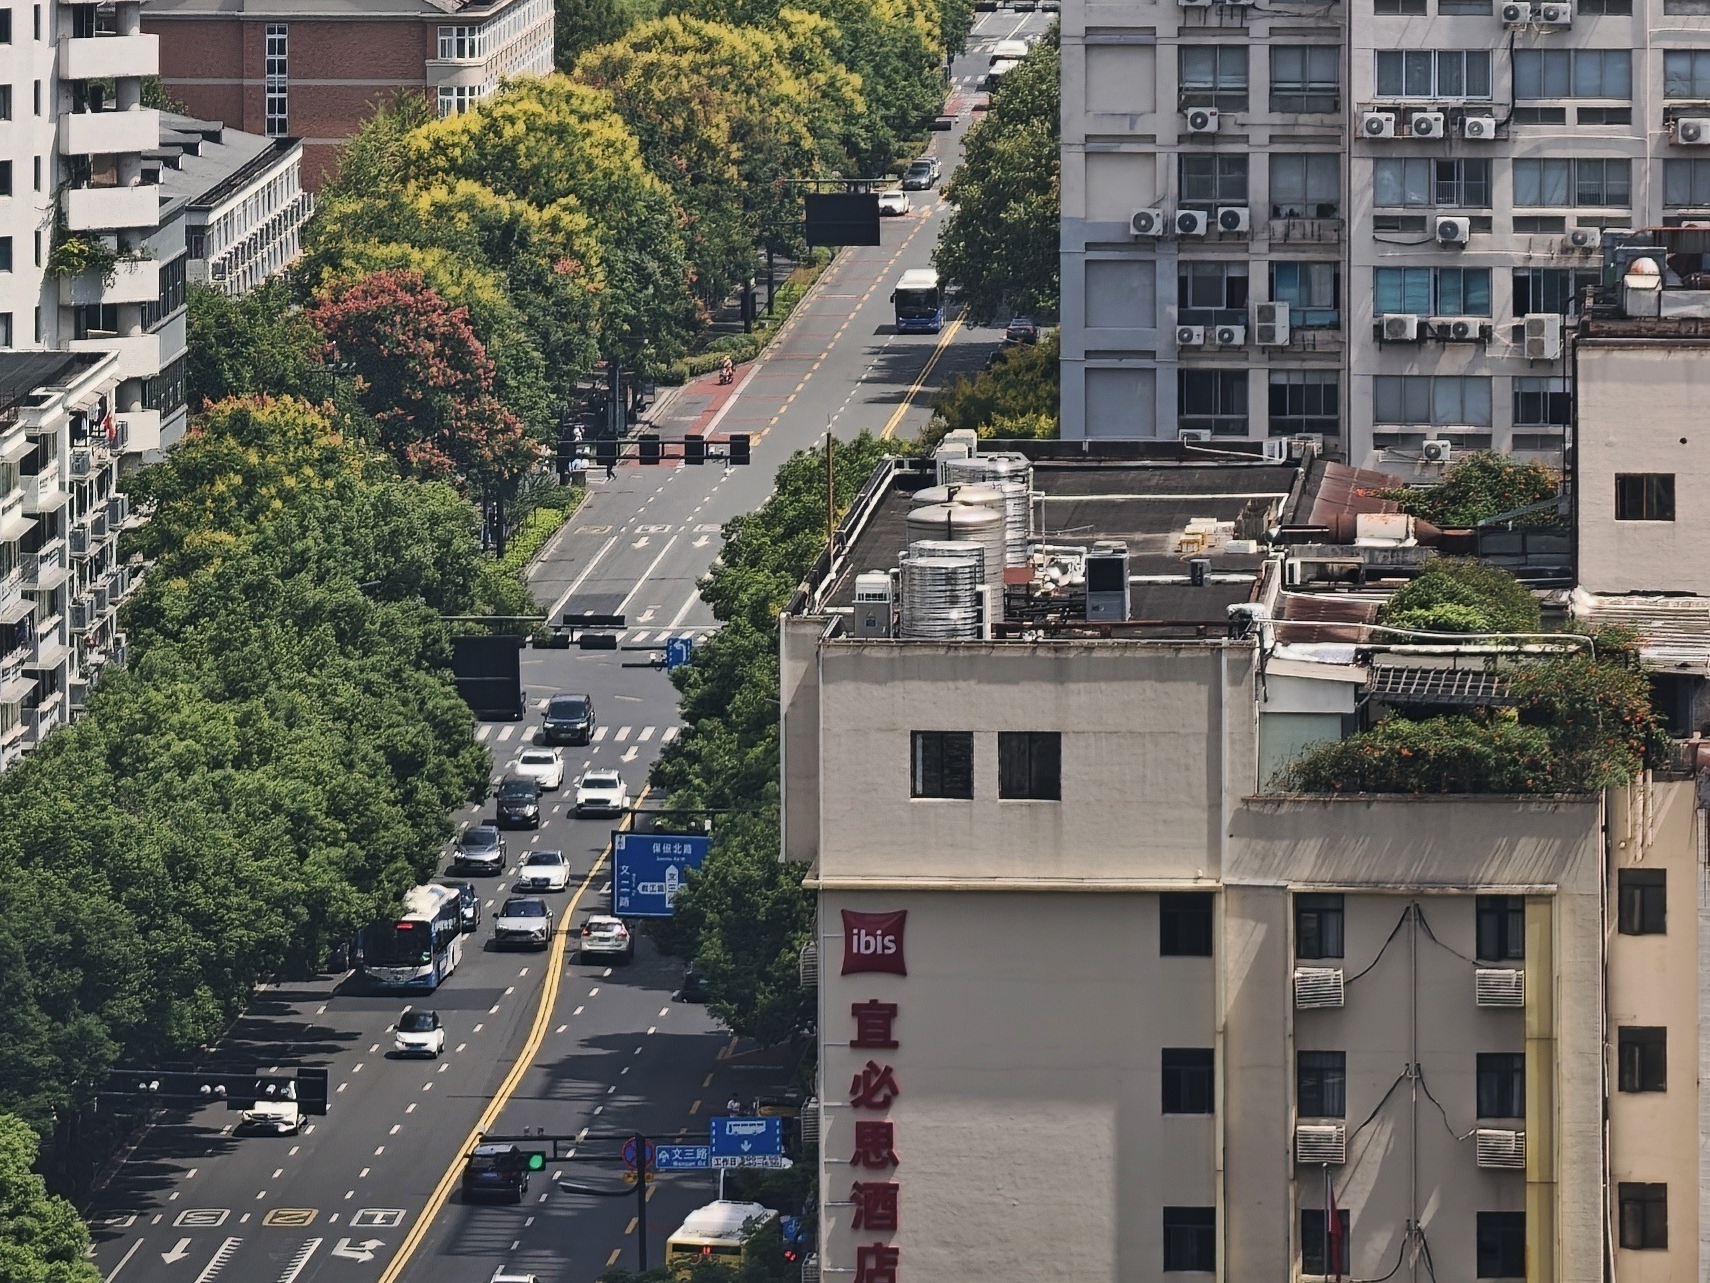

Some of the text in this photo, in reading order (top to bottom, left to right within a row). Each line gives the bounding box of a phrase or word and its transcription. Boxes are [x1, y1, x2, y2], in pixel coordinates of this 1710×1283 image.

[852, 928, 897, 955] ibis
[671, 1147, 707, 1160] 文三路
[848, 999, 900, 1283] 宜必思酒店
